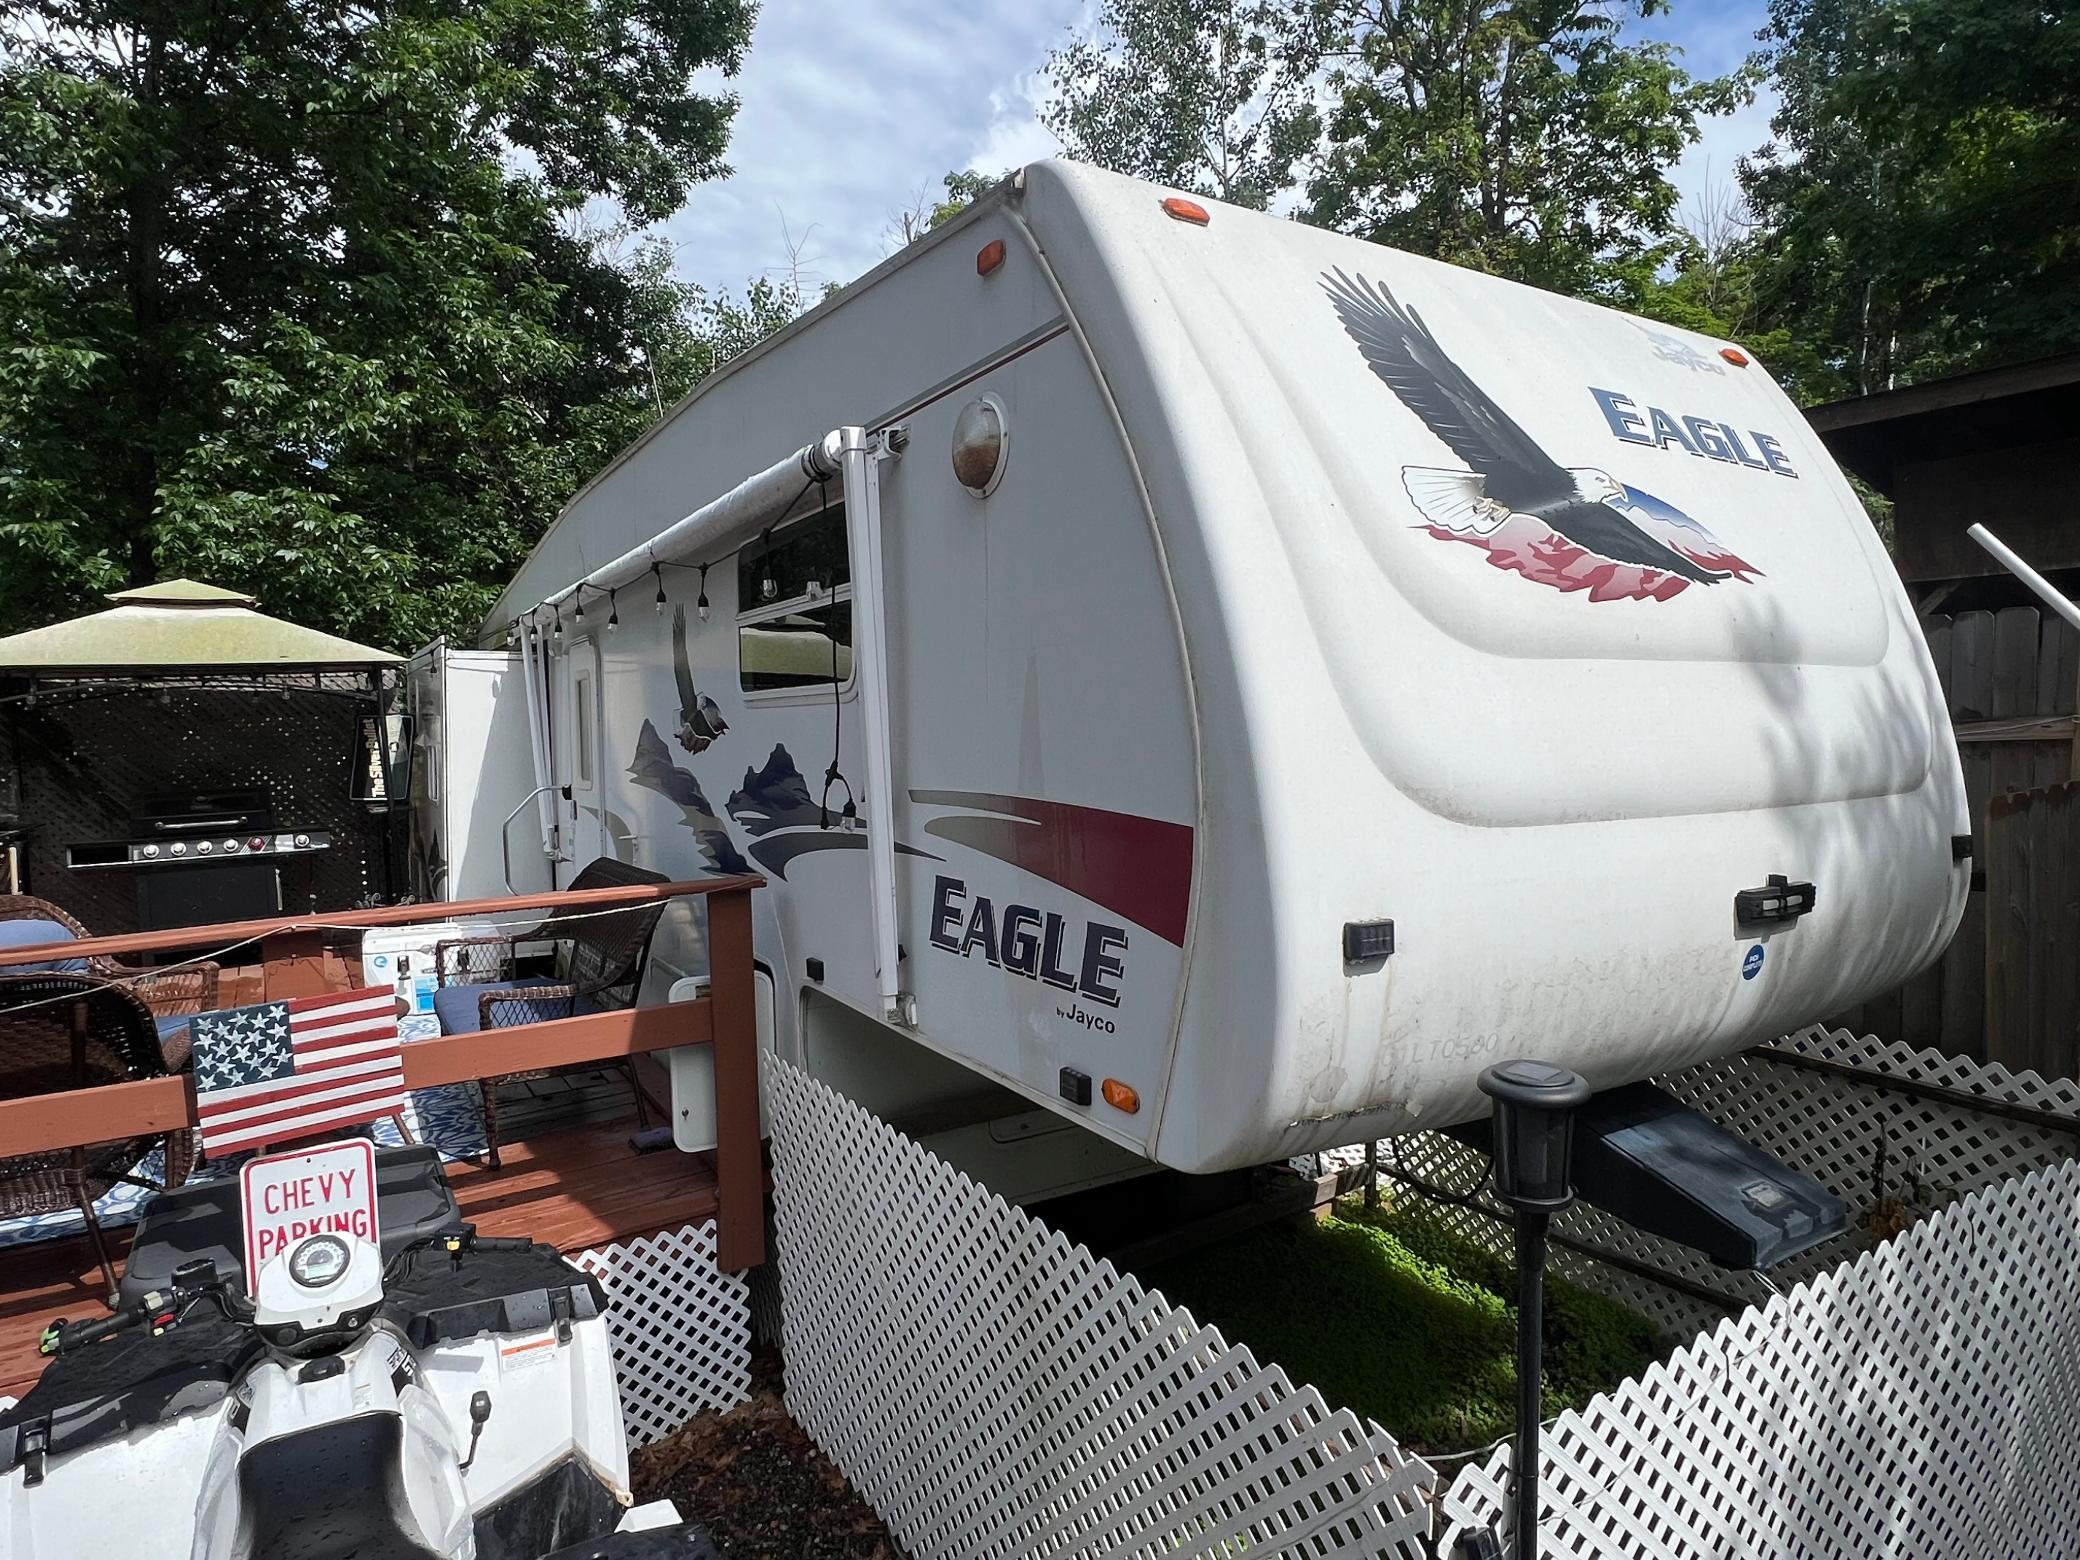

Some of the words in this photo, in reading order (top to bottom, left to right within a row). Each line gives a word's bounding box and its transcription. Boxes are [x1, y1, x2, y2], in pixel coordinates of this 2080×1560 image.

[1588, 386, 1799, 480] EAGLE
[368, 749, 384, 778] Silver
[371, 778, 386, 798] The
[929, 874, 1129, 1008] EAGLE
[1056, 1005, 1065, 1019] by
[1066, 1003, 1116, 1034] Jayco
[264, 1168, 356, 1215] CHEVY
[258, 1208, 368, 1260] PARKING
